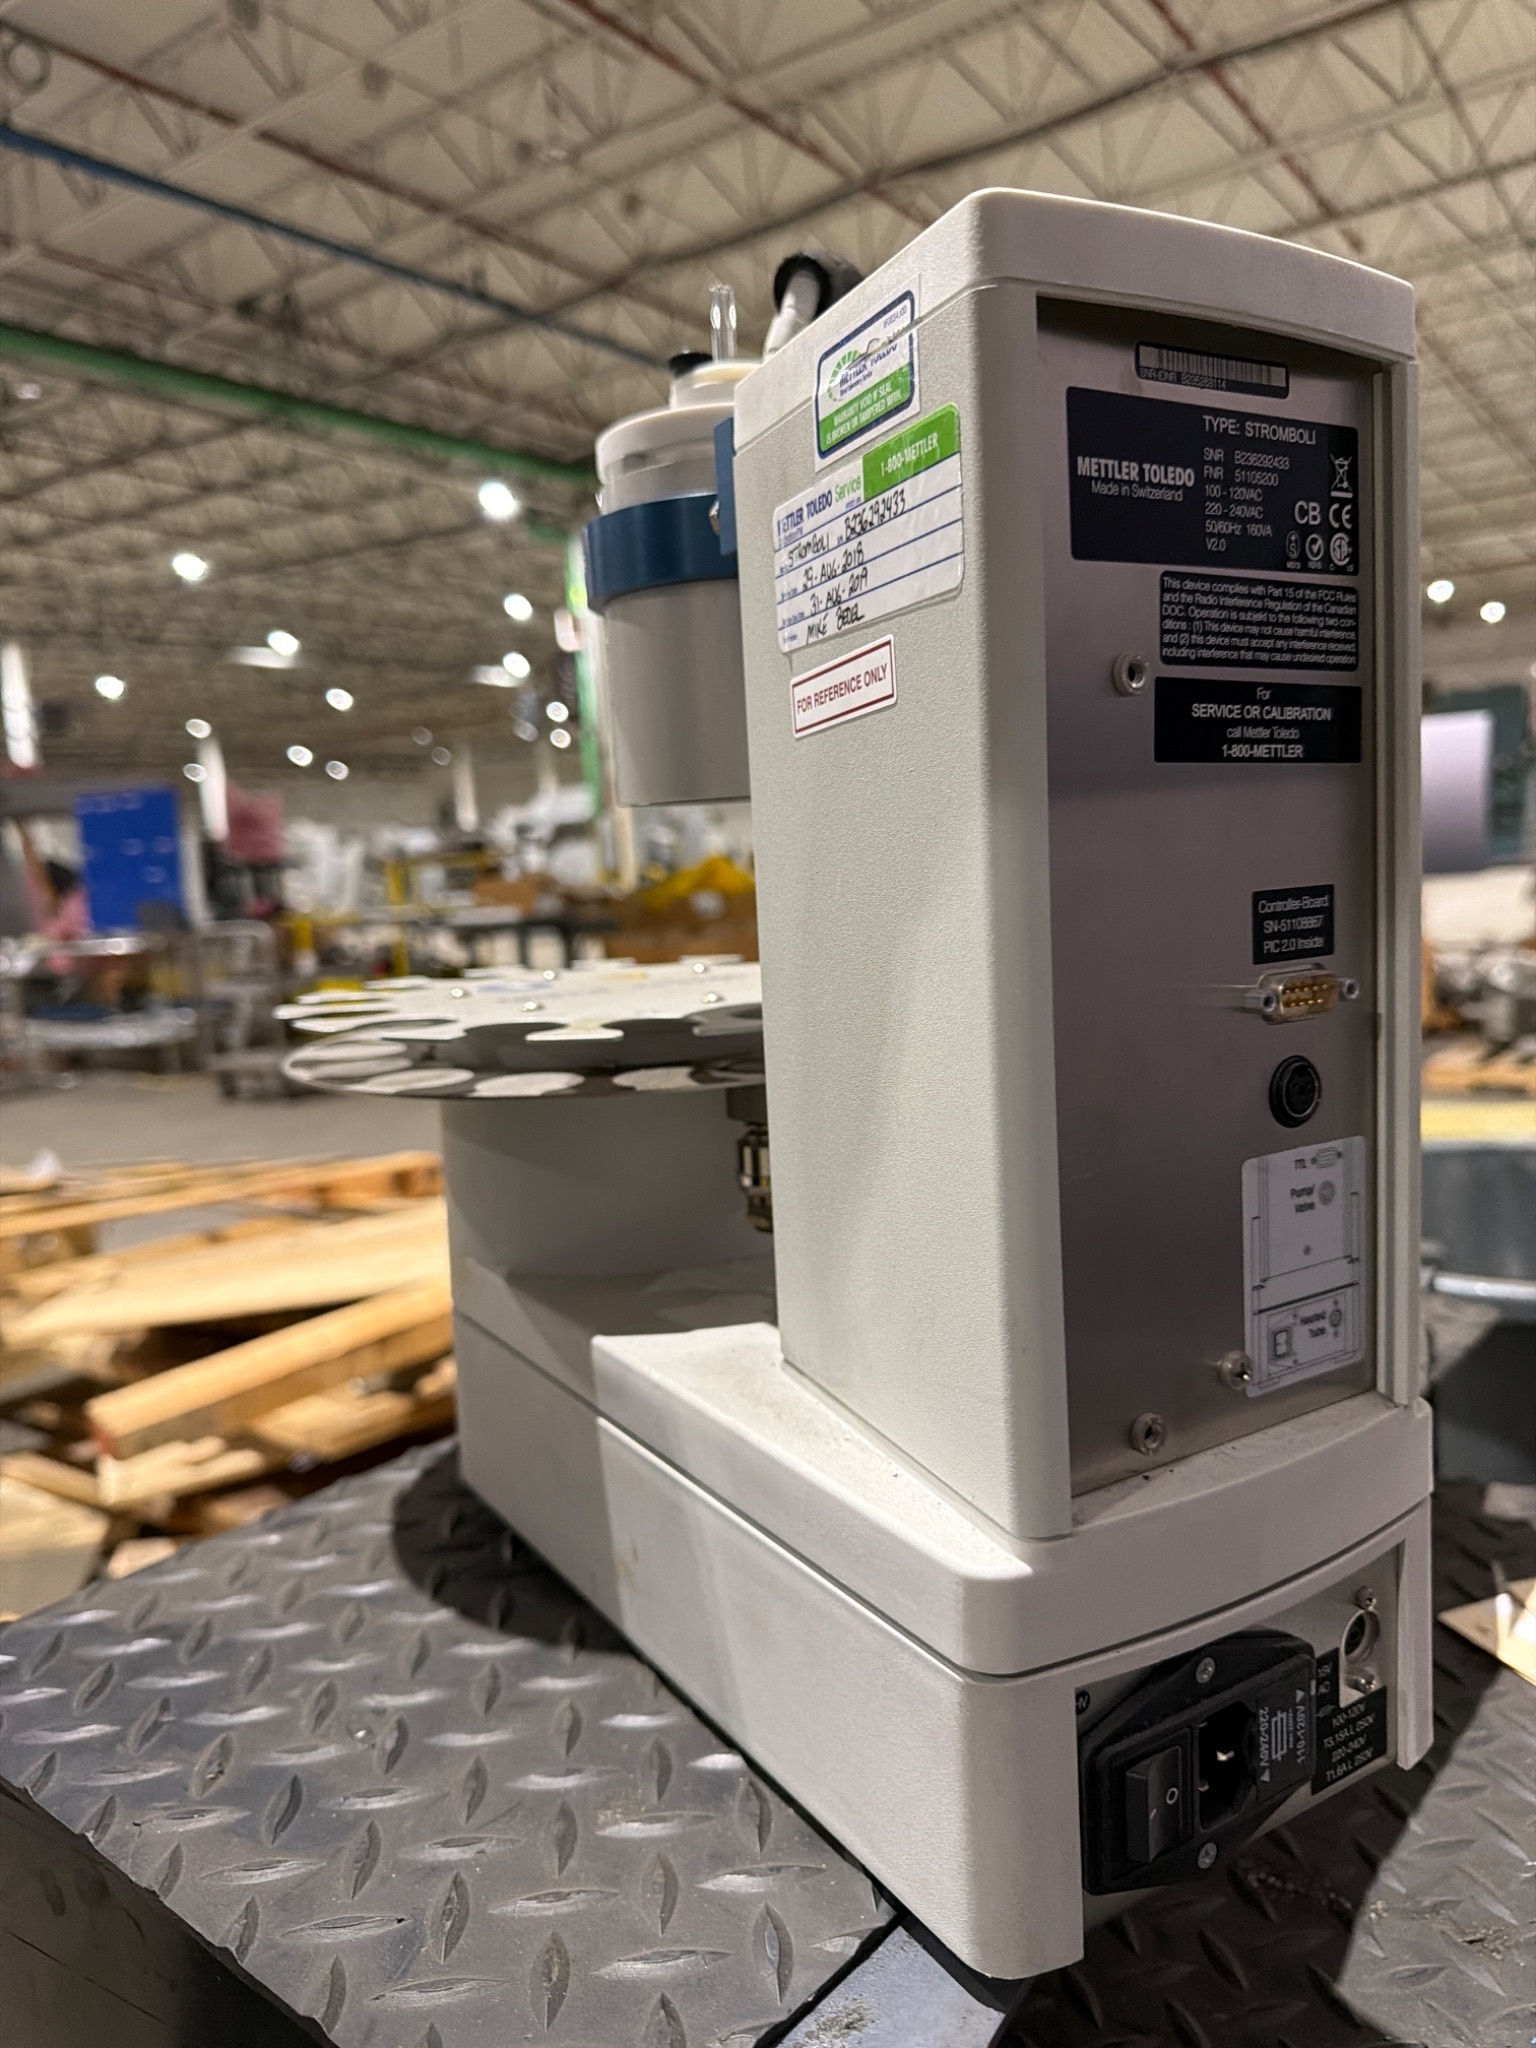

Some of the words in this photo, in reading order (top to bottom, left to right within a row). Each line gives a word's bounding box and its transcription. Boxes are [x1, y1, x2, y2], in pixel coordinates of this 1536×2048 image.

[1203, 414, 1241, 436] TYPE:
[1244, 421, 1317, 445] STROMBOLI
[880, 431, 940, 478] 1-800-METTLER
[1203, 447, 1224, 462] SNR
[1077, 455, 1140, 482] METTLER
[1142, 462, 1196, 488] TOLEDO
[1203, 465, 1224, 480] FNR
[805, 489, 833, 520] TOLEDO
[834, 475, 863, 503] Service
[1091, 480, 1119, 496] Made
[1120, 482, 1130, 497] in
[1131, 483, 1184, 502] Switzerland
[1205, 484, 1222, 498] 100
[1229, 486, 1263, 502] 120VAC
[1205, 502, 1222, 516] 220
[1229, 504, 1265, 520] 240VAC
[1294, 500, 1322, 525] CB
[1205, 519, 1243, 535] 50/60Hz
[1205, 537, 1227, 552] V2.0
[1162, 577, 1181, 590] This
[1182, 579, 1210, 592] device
[1211, 582, 1249, 596] complies
[1251, 584, 1266, 596] with
[1267, 585, 1282, 598] Part
[1284, 587, 1294, 598] 15
[1295, 588, 1304, 600] of
[1304, 588, 1317, 600] the
[1317, 590, 1335, 601] FCC
[1162, 592, 1180, 603] and
[1180, 592, 1194, 604] the
[1194, 593, 1218, 605] Radio
[1264, 598, 1302, 613] Regulation
[1303, 601, 1312, 612] of
[1312, 602, 1324, 613] the
[1324, 602, 1356, 615] Canadian
[1162, 604, 1186, 617] DOC.
[1188, 605, 1228, 620] Operation
[1230, 609, 1238, 621] is
[1238, 610, 1268, 624] subject
[1269, 613, 1278, 623] to
[1278, 612, 1291, 624] the
[1292, 614, 1325, 629] following
[1325, 616, 1339, 627] two
[1340, 618, 1357, 628] con-
[1162, 618, 1188, 631] ditions
[1193, 620, 1203, 634] (1)
[1204, 620, 1219, 633] This
[1220, 622, 1244, 634] device
[1245, 625, 1260, 637] may
[1261, 626, 1272, 636] not
[1273, 627, 1294, 637] cause
[1162, 632, 1179, 644] and
[1179, 632, 1189, 647] (2)
[1190, 634, 1205, 645] this
[1205, 634, 1230, 646] device
[1231, 636, 1250, 648] must
[1250, 638, 1274, 650] accept
[1274, 640, 1288, 651] any
[1288, 640, 1328, 651] interference
[1162, 645, 1196, 661] including
[1197, 646, 1239, 660] interference
[1240, 648, 1253, 660] that
[1254, 650, 1270, 663] may
[1271, 652, 1292, 663] cause
[1292, 652, 1327, 664] undesired
[796, 695, 813, 715] FOR
[813, 674, 862, 708] REFERENCE
[863, 662, 888, 688] ONLY
[1256, 687, 1272, 701] For
[1191, 703, 1243, 719] SERVICE
[1244, 704, 1261, 719] OR
[1262, 705, 1333, 721] CALIBRATION
[1227, 726, 1242, 739] call
[1243, 726, 1271, 740] Mettler
[1271, 726, 1300, 740] Toledo
[1222, 743, 1304, 759] 1-800-METTLER
[1258, 894, 1329, 914] Controller-Board
[1264, 939, 1280, 954] PIC
[1281, 938, 1297, 952] 2.0
[1297, 935, 1325, 950] Inside
